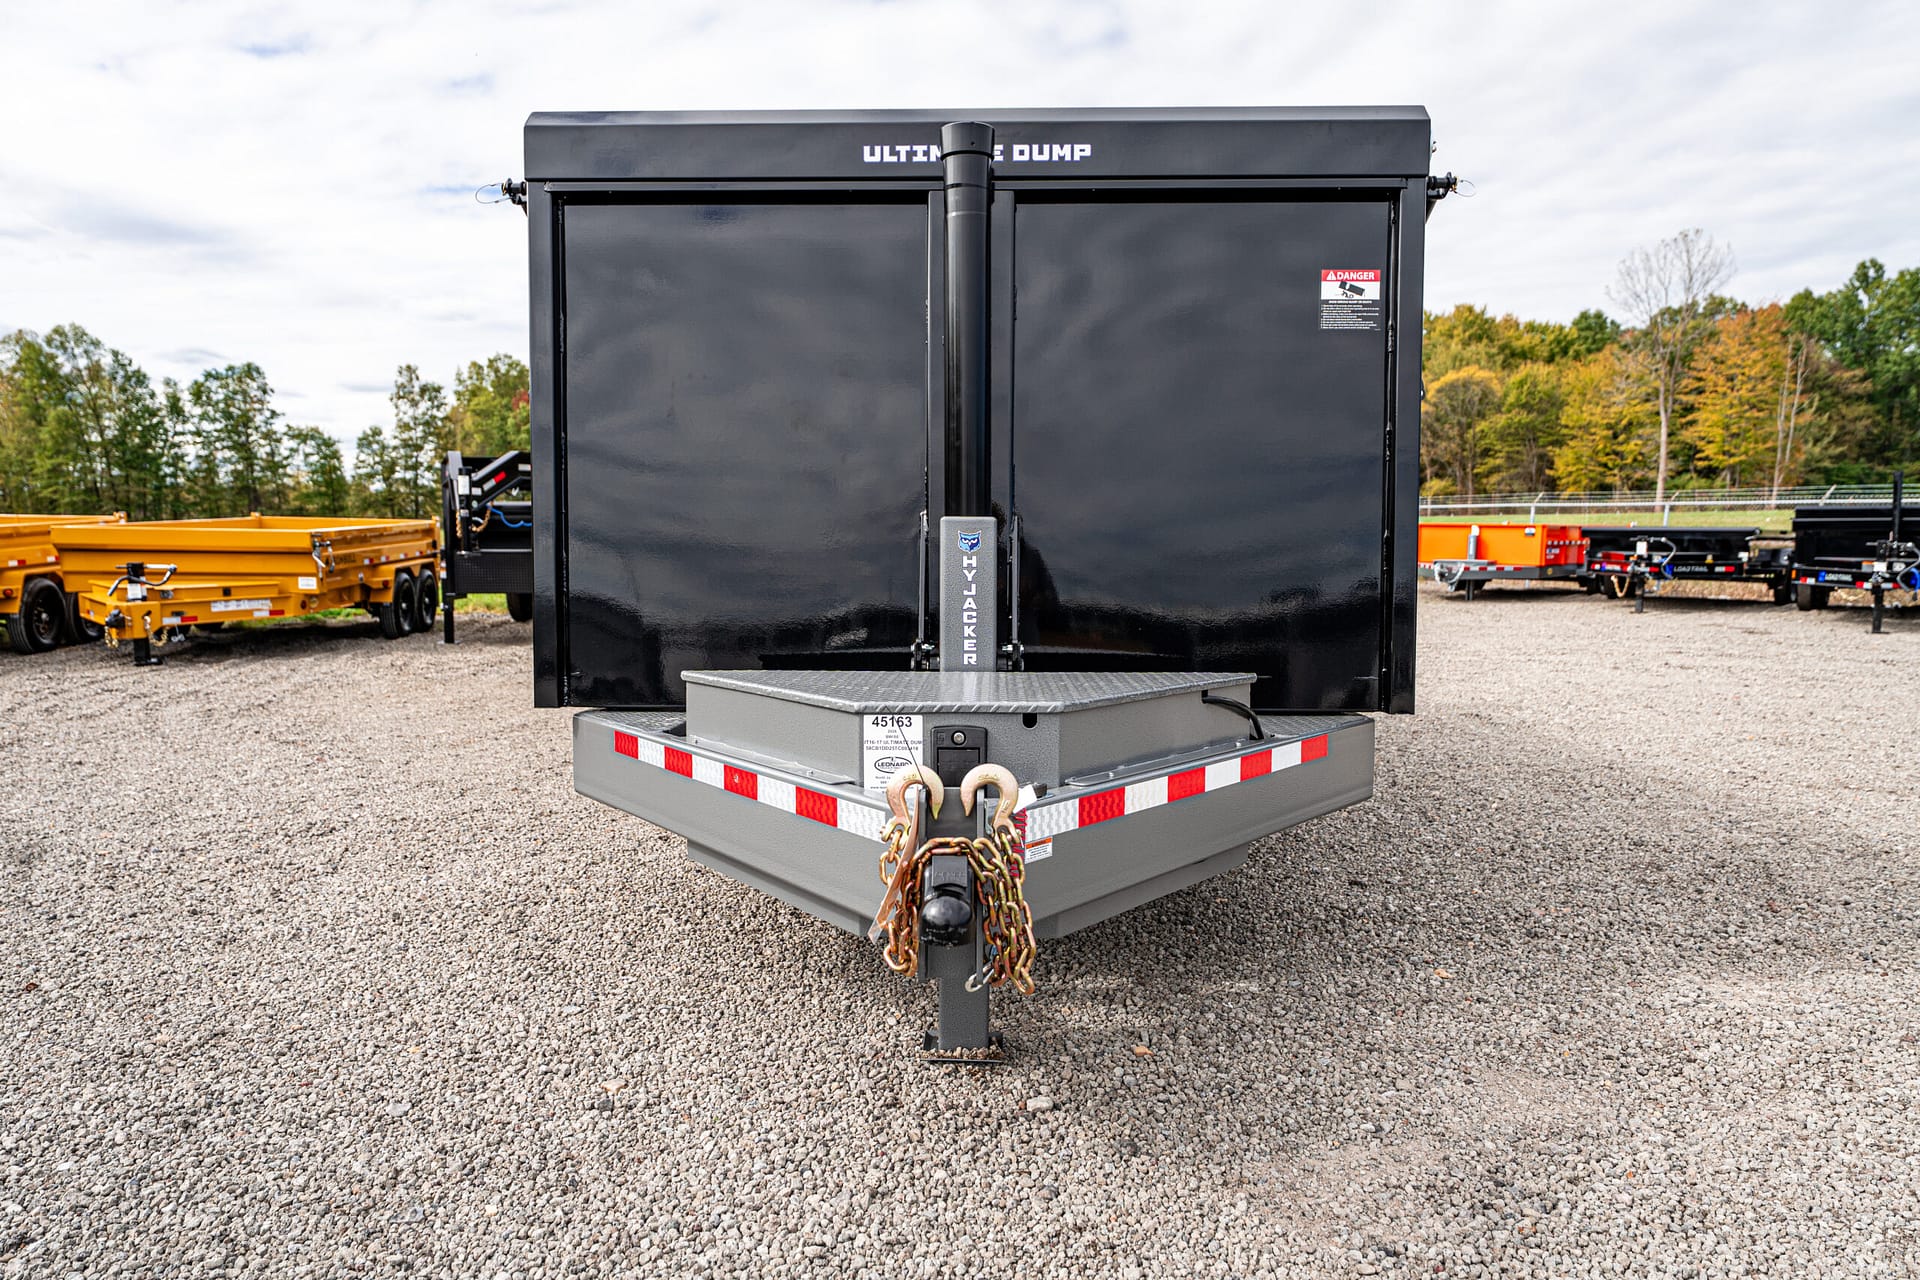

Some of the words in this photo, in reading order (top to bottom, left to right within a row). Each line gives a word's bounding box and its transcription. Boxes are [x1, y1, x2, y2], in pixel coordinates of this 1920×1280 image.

[863, 145, 1004, 162] ULTIME
[1012, 144, 1092, 161] DUMP
[1336, 271, 1375, 280] DANGER
[962, 555, 977, 665] HYJACKER
[871, 716, 912, 727] 45163
